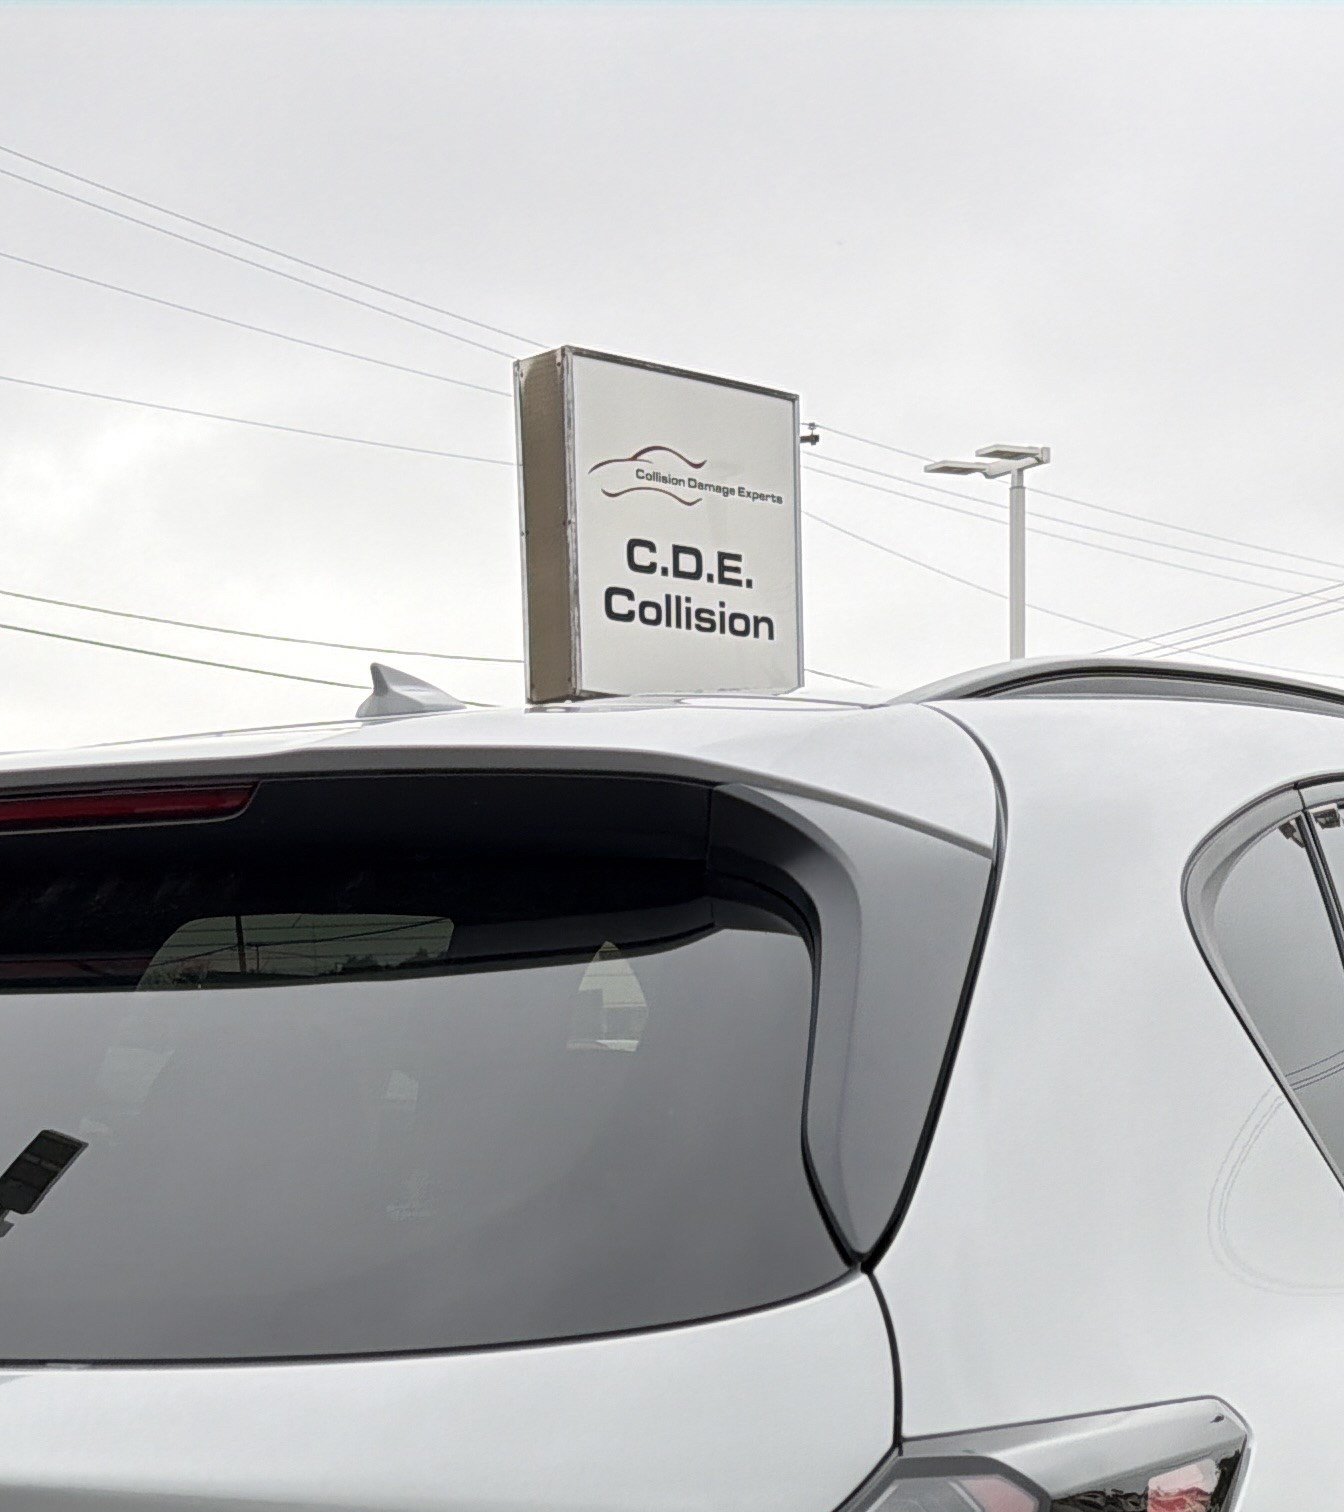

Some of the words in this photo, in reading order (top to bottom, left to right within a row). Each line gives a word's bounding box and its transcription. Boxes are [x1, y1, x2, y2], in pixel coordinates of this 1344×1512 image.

[635, 468, 686, 488] Collision
[687, 476, 736, 498] Damage
[738, 486, 784, 505] Experts
[626, 538, 754, 589] C.D.E.
[603, 586, 775, 641] Collision
